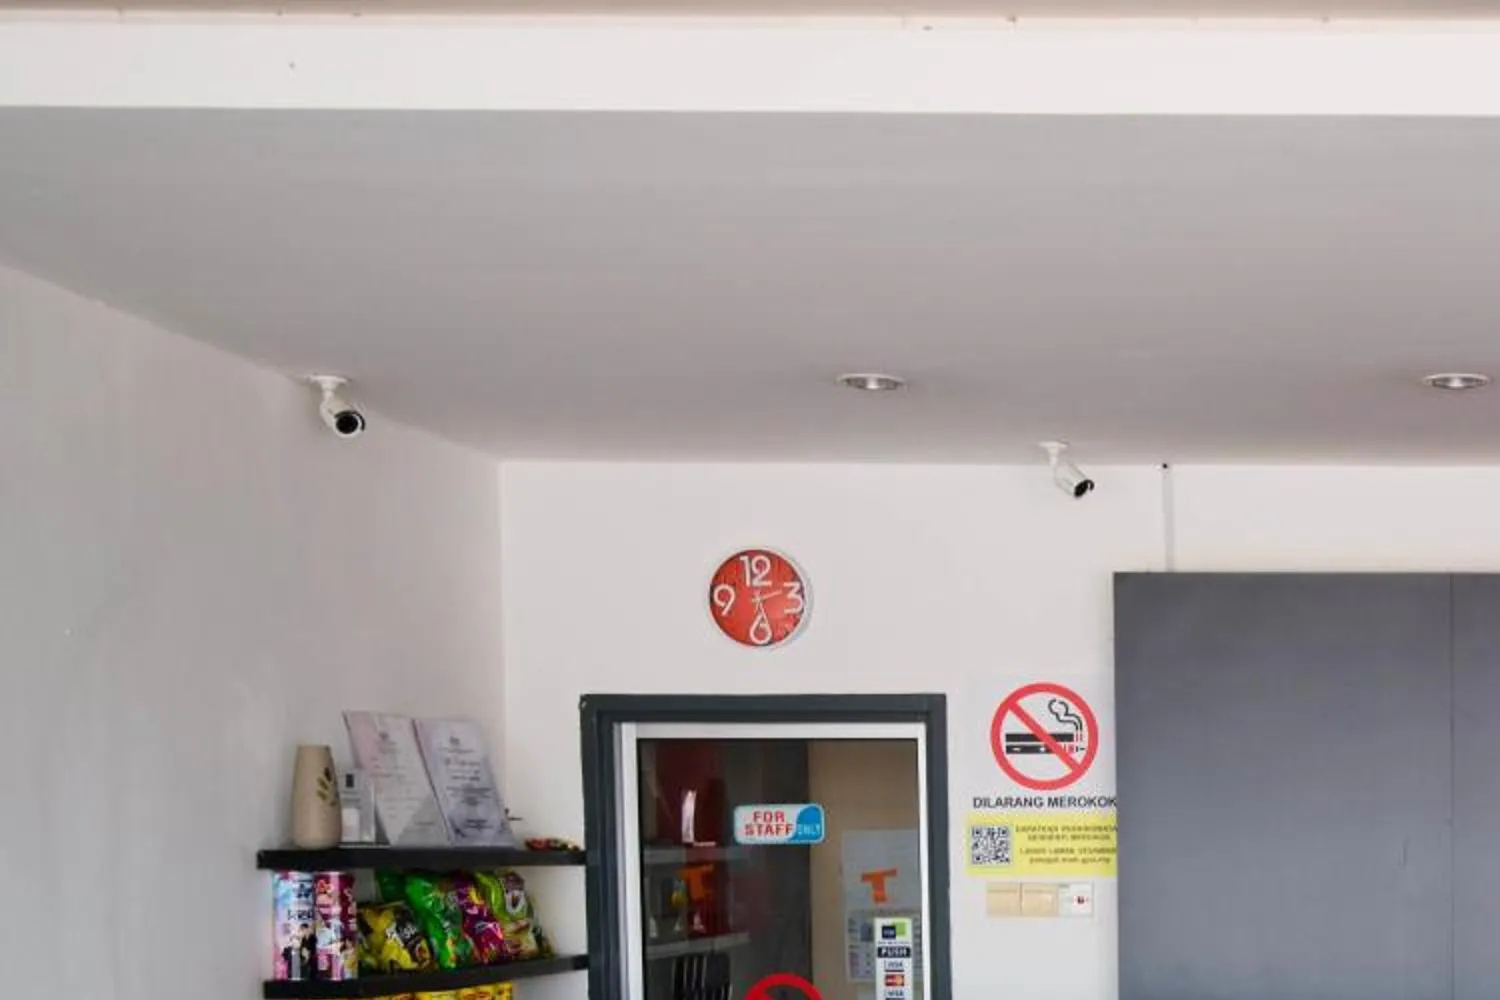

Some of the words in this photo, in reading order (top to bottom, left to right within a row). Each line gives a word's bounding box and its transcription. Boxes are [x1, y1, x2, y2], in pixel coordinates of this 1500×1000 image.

[740, 555, 773, 587] 12
[713, 583, 736, 616] 9
[783, 581, 803, 613] 3
[749, 609, 772, 645] 6
[753, 810, 785, 823] FOR
[972, 796, 1044, 809] DILARANG
[1047, 796, 1118, 809] MEROKOK
[744, 823, 794, 836] STAFF
